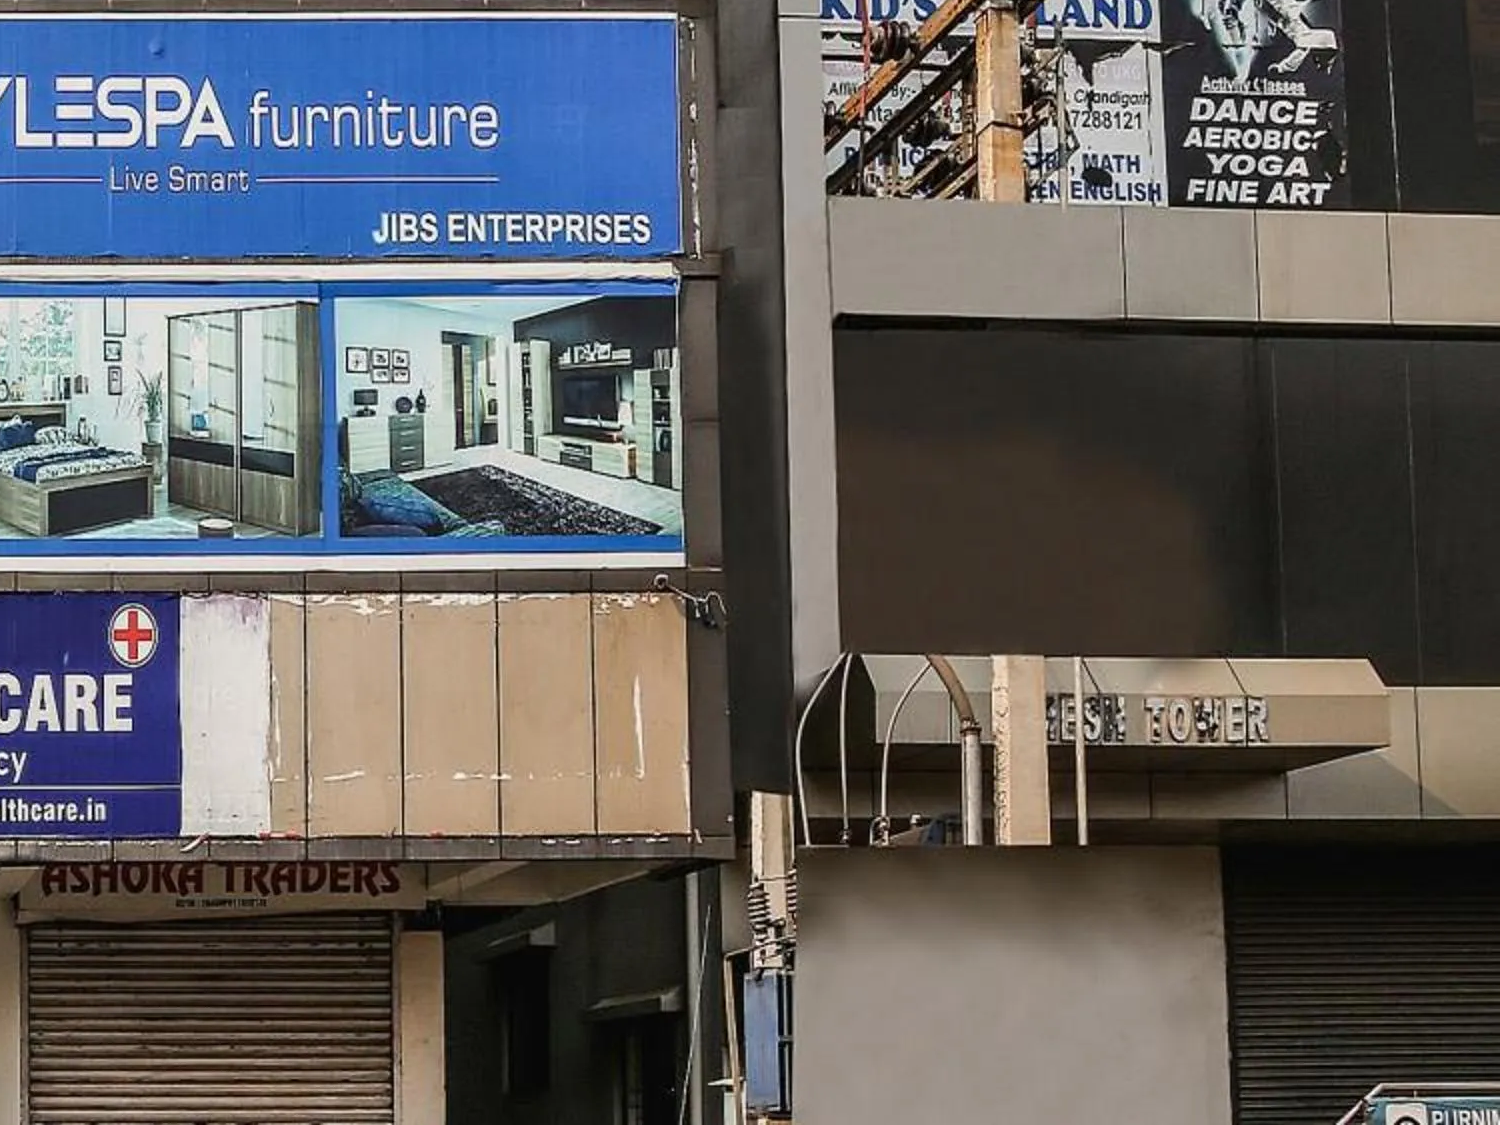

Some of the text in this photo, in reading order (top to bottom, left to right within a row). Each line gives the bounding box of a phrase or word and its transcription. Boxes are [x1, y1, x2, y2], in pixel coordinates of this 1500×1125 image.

[249, 89, 499, 149] furniture
[1189, 97, 1320, 125] DANCE
[1082, 154, 1141, 174] MATH
[1206, 153, 1309, 177] YOGA
[108, 165, 251, 193] Live Smart
[1070, 180, 1162, 202] ENGLISH
[1186, 179, 1332, 206] FINE ART
[372, 212, 652, 244] JIBS ENTERPRISES
[1144, 695, 1270, 743] TOWER
[40, 862, 401, 897] ASHOKA TRADERS
